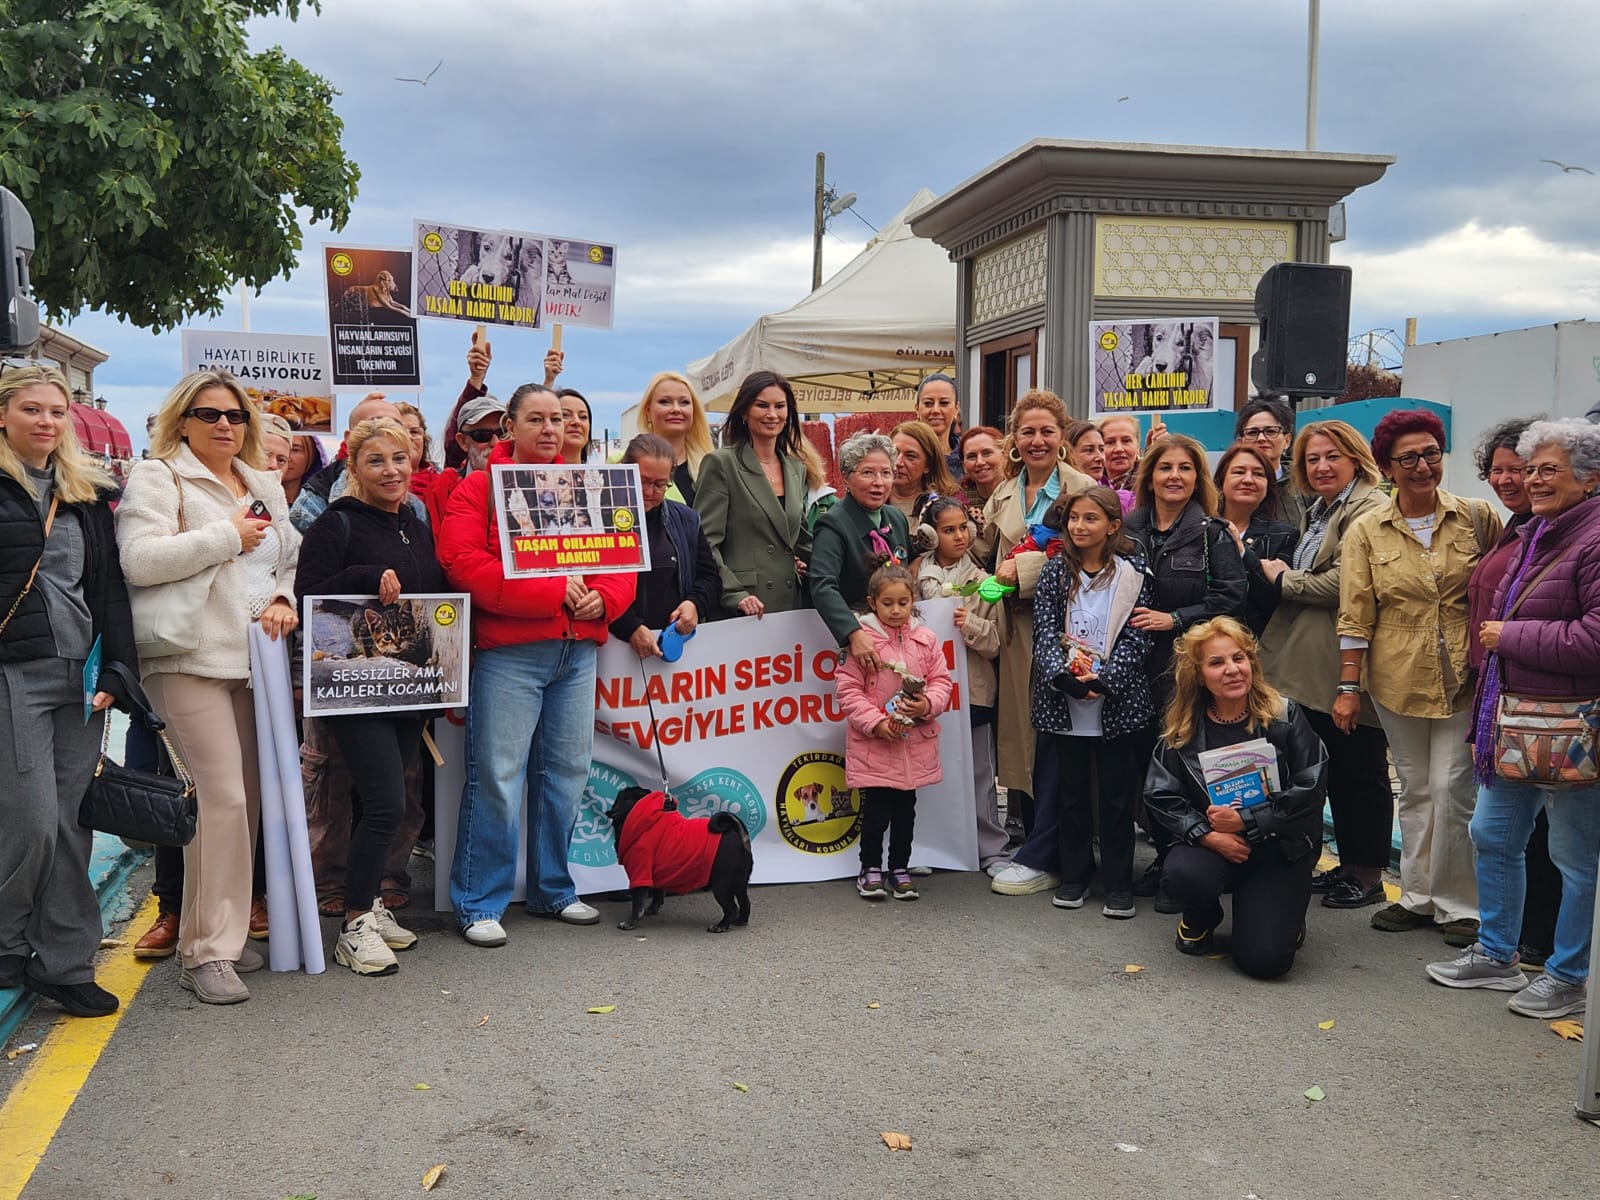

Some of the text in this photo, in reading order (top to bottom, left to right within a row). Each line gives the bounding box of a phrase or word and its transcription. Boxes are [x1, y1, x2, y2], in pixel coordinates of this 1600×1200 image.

[449, 280, 514, 303] HER CANLININ
[563, 287, 581, 299] Mal
[583, 289, 608, 303] Değil
[425, 295, 536, 324] YAŞAMA HAKKI VARDIR!
[204, 348, 316, 365] HAYATI BİRLİKTE
[338, 344, 412, 356] İNSANLARIN SEVGİSİ
[355, 358, 397, 371] TÜKENİYOR
[1125, 372, 1186, 389] HER CANLININ
[1103, 389, 1208, 410] YAŞAMA HAKKI VARDIR!
[515, 535, 636, 556] YAŞAM ONLARIN DA
[556, 551, 600, 564] HAKKI!
[331, 667, 444, 682] SESSİZLER AMA
[734, 644, 803, 691] SESİ
[317, 681, 458, 699] KALPLERİ KOCAMAN!
[718, 776, 742, 791] KENT
[816, 835, 853, 853] KORUMA
